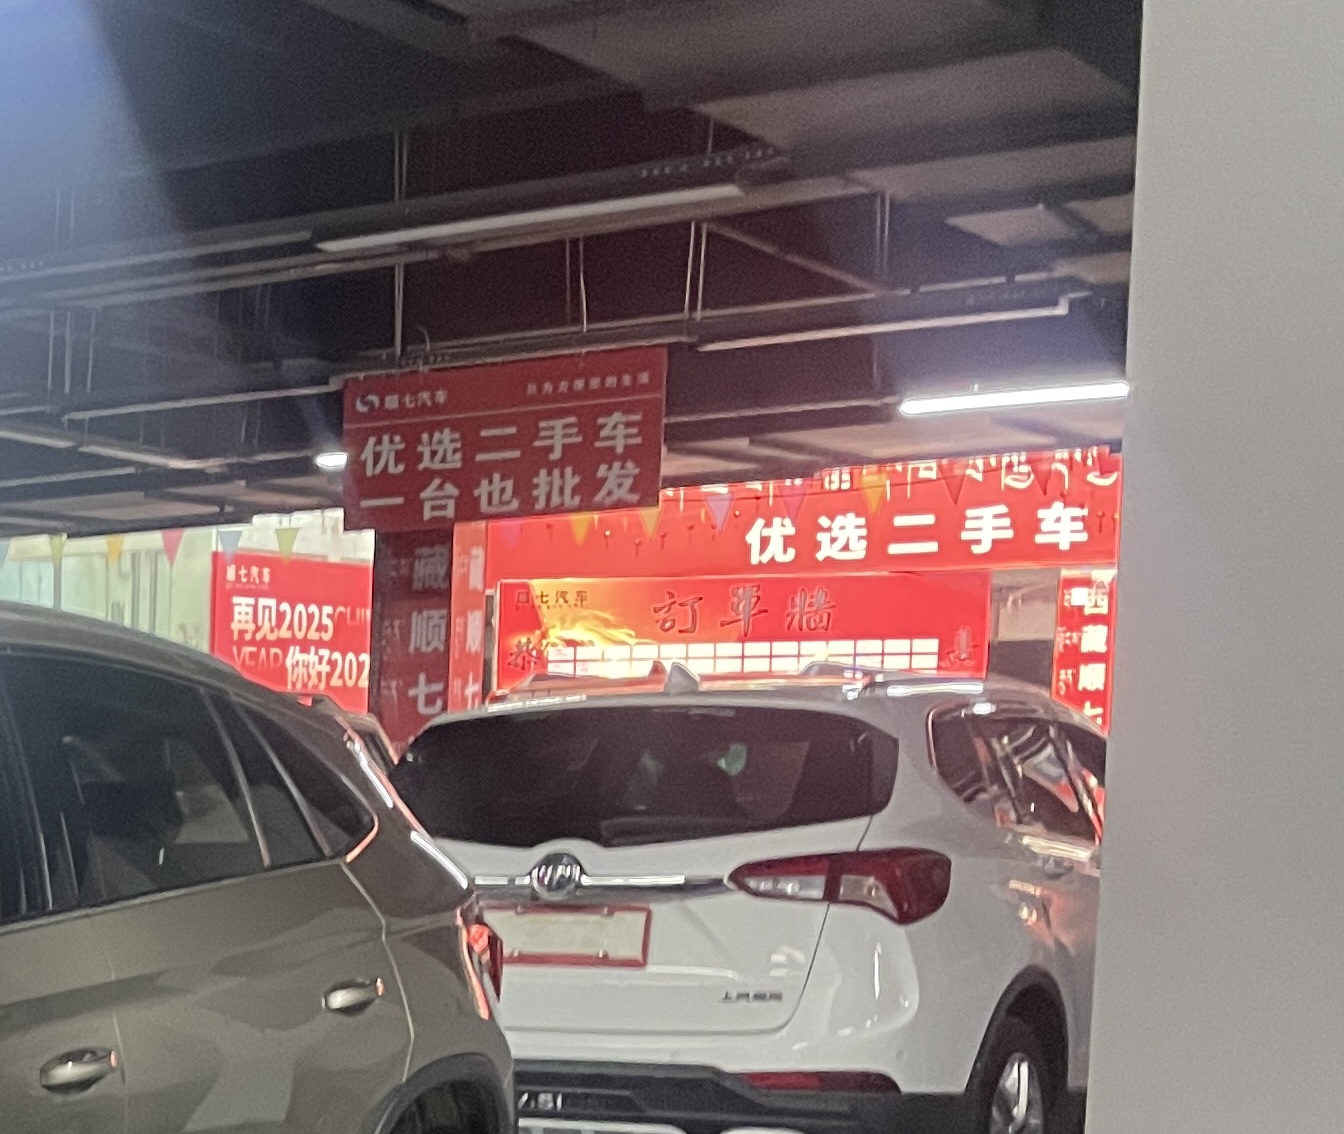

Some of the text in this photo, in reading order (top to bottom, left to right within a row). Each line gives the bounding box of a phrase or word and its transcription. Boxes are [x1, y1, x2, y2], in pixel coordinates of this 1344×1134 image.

[360, 411, 644, 476] 优选二手车
[360, 461, 642, 521] 一台也批发
[745, 501, 1089, 565] 优选二手车
[231, 596, 334, 642] 再见2025
